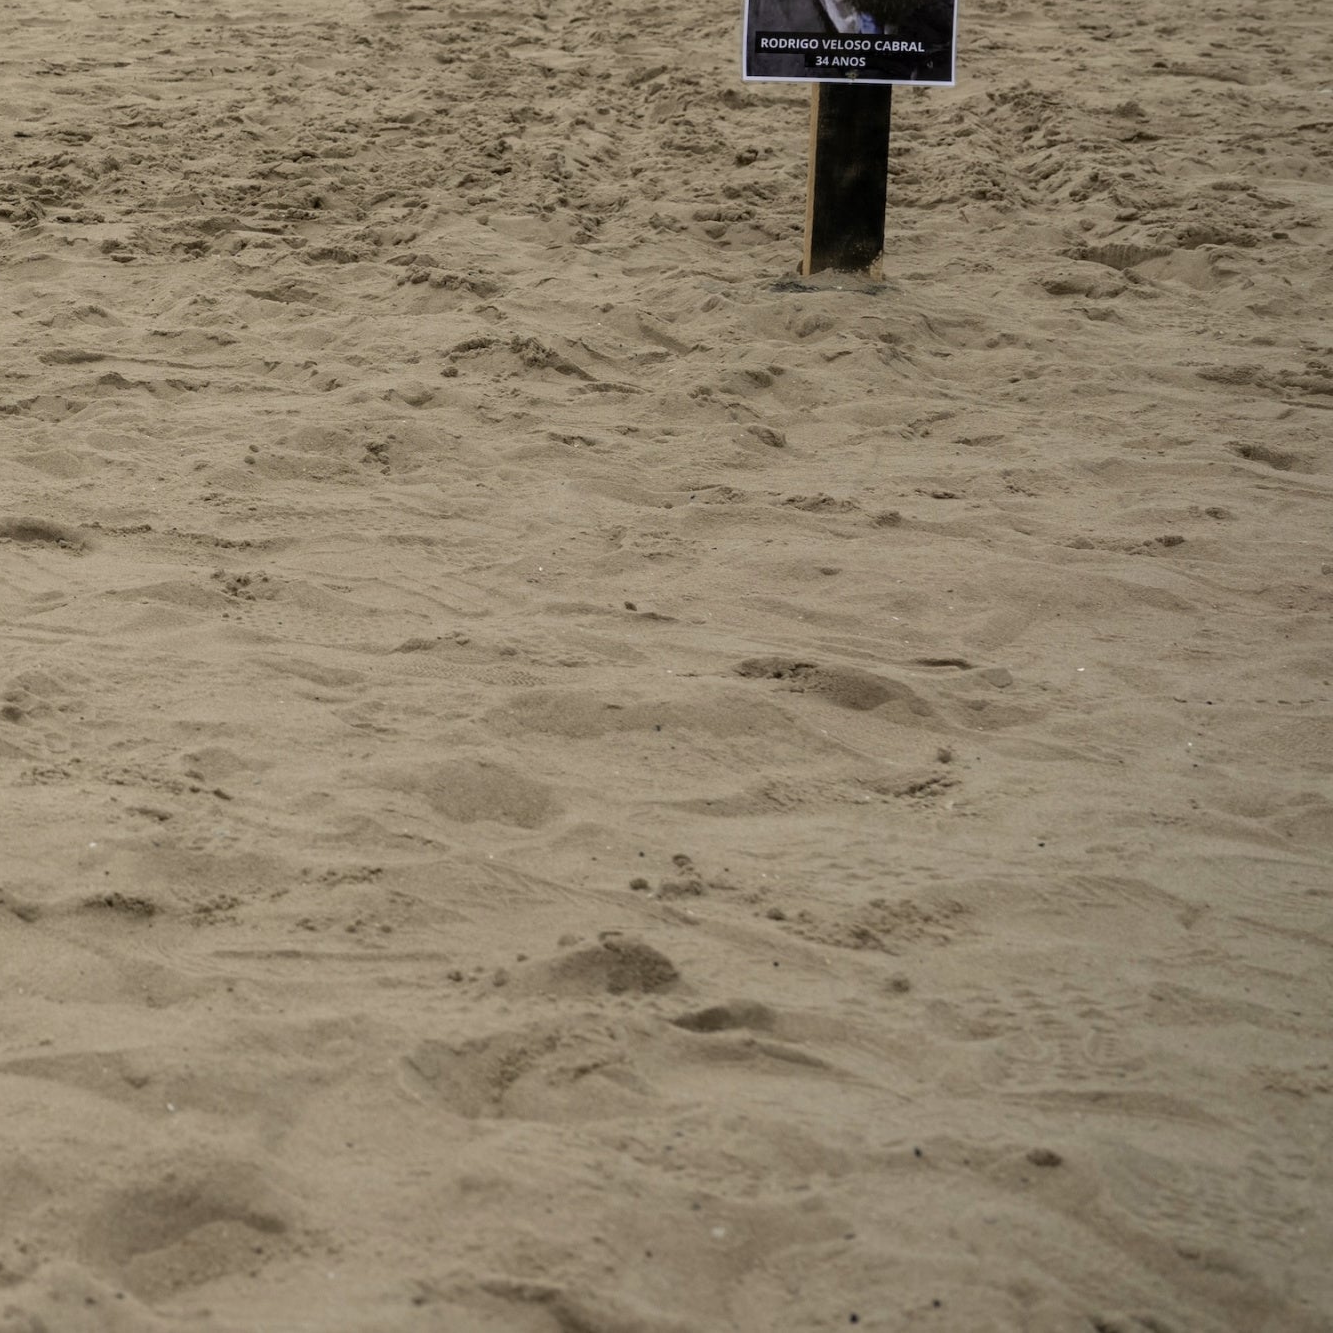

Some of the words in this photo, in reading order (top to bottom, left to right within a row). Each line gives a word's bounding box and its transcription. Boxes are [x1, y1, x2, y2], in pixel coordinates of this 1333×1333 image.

[760, 37, 819, 49] RODRIGO
[822, 39, 872, 51] VELOSO
[874, 40, 925, 52] CABRAL
[815, 56, 829, 66] 34
[831, 56, 866, 67] ANOS
